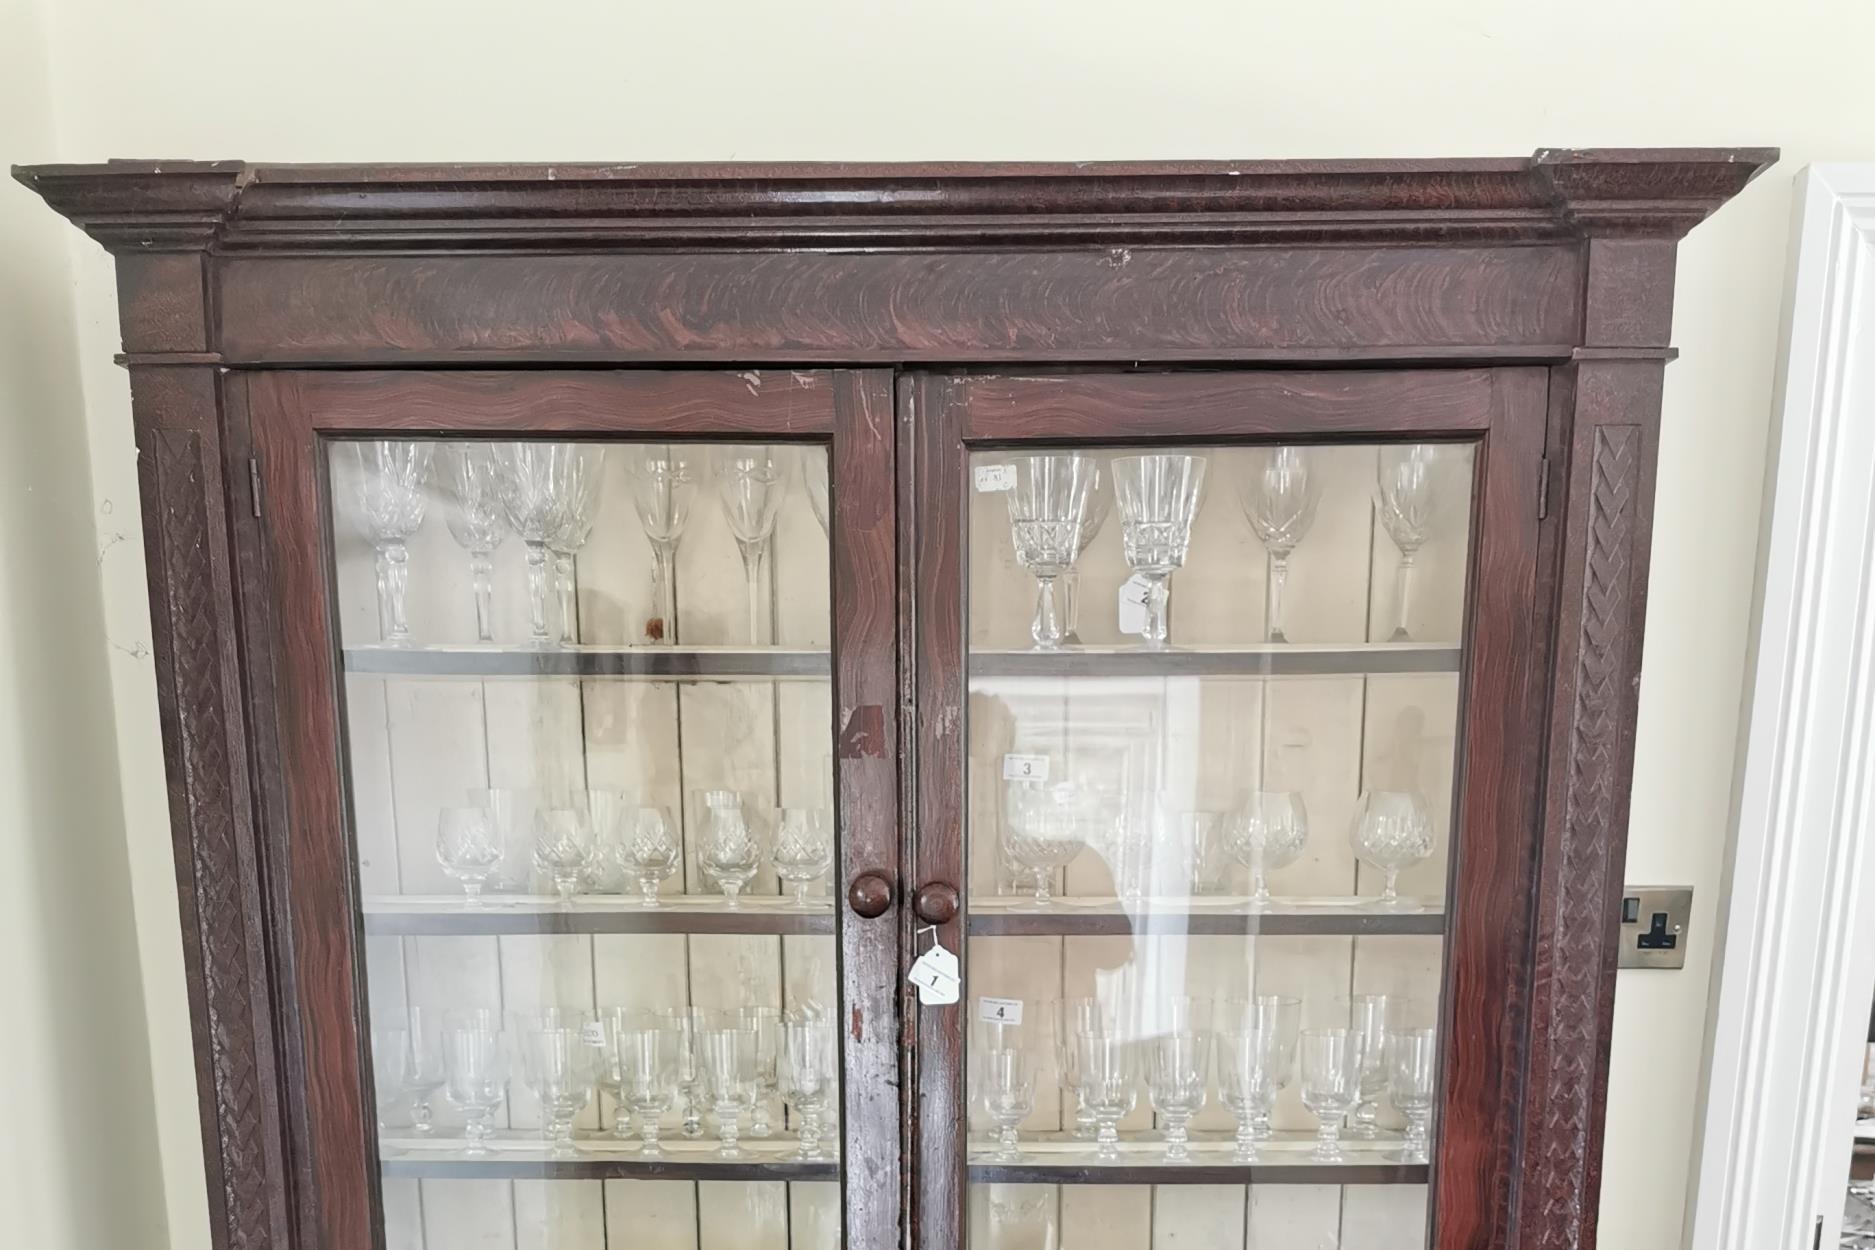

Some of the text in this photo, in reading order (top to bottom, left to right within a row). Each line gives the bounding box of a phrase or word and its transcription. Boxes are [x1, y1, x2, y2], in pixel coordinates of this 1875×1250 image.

[1023, 762, 1032, 775] 3
[930, 975, 939, 986] 1
[996, 1006, 1005, 1018] 4
